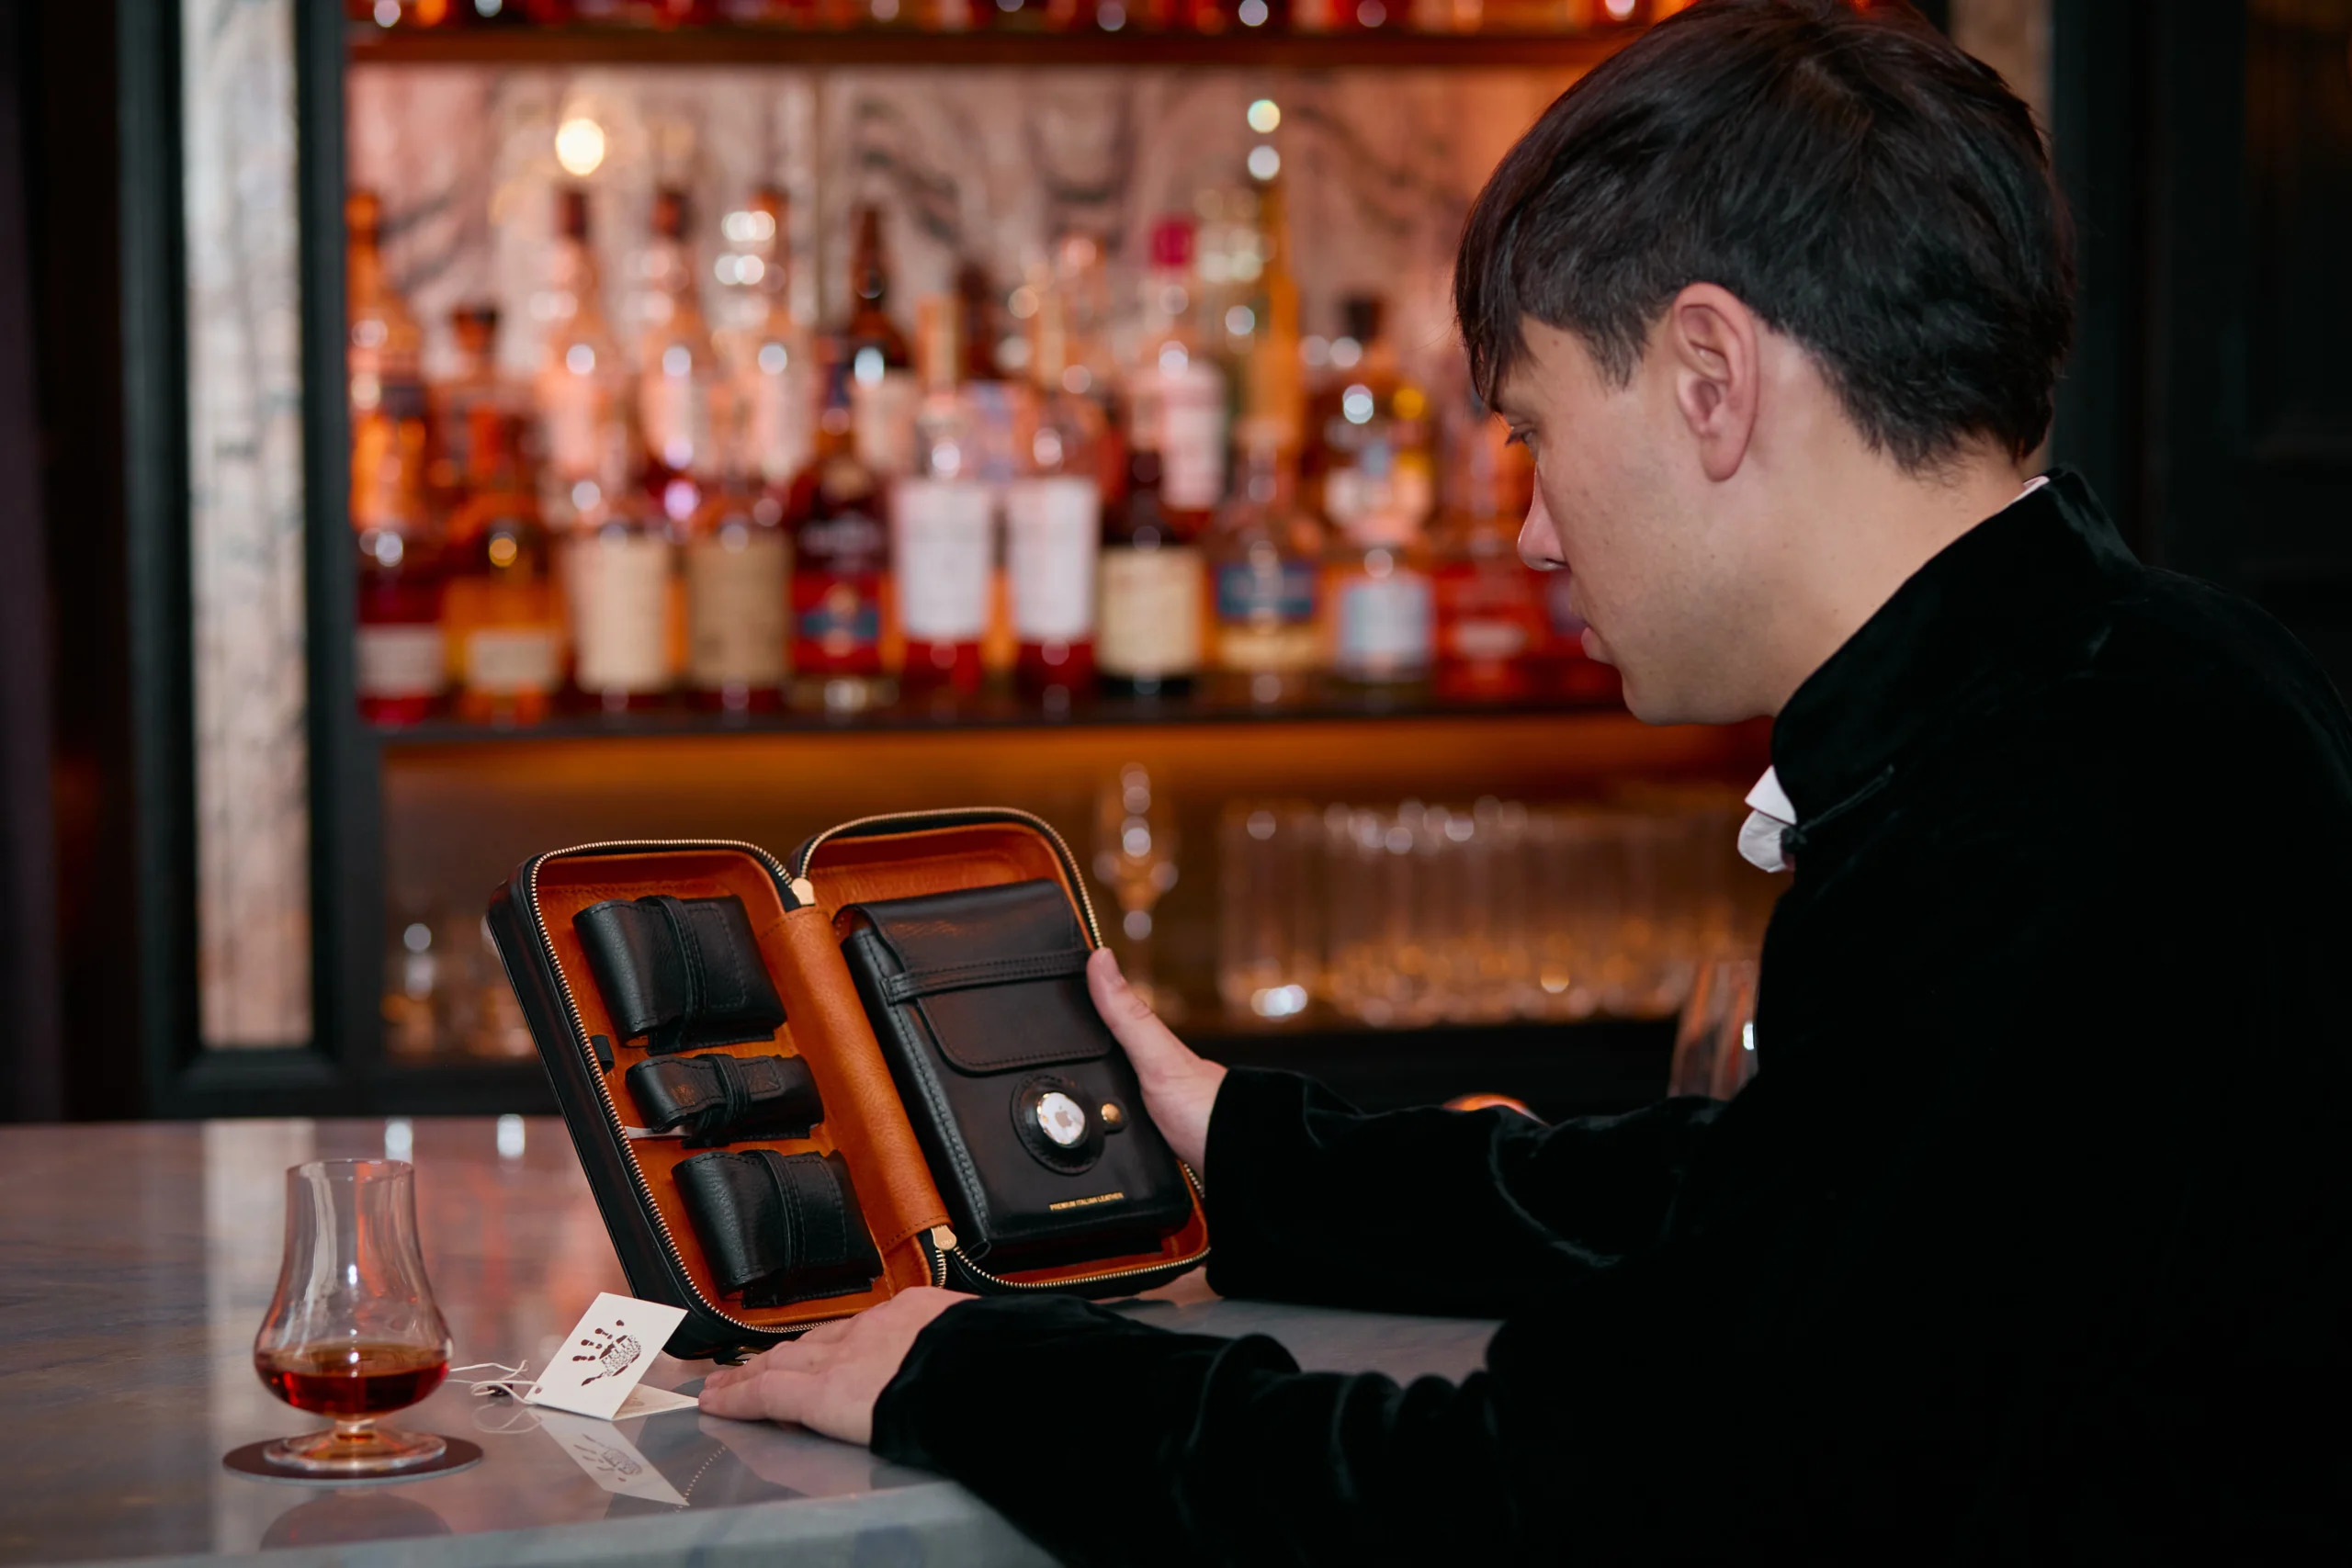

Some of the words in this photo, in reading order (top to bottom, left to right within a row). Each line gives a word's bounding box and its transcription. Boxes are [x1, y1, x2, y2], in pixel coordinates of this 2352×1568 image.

[1049, 1200, 1076, 1211] PREMIUM
[1075, 1196, 1098, 1206] ITALIAN
[1097, 1191, 1124, 1203] LEATHER
